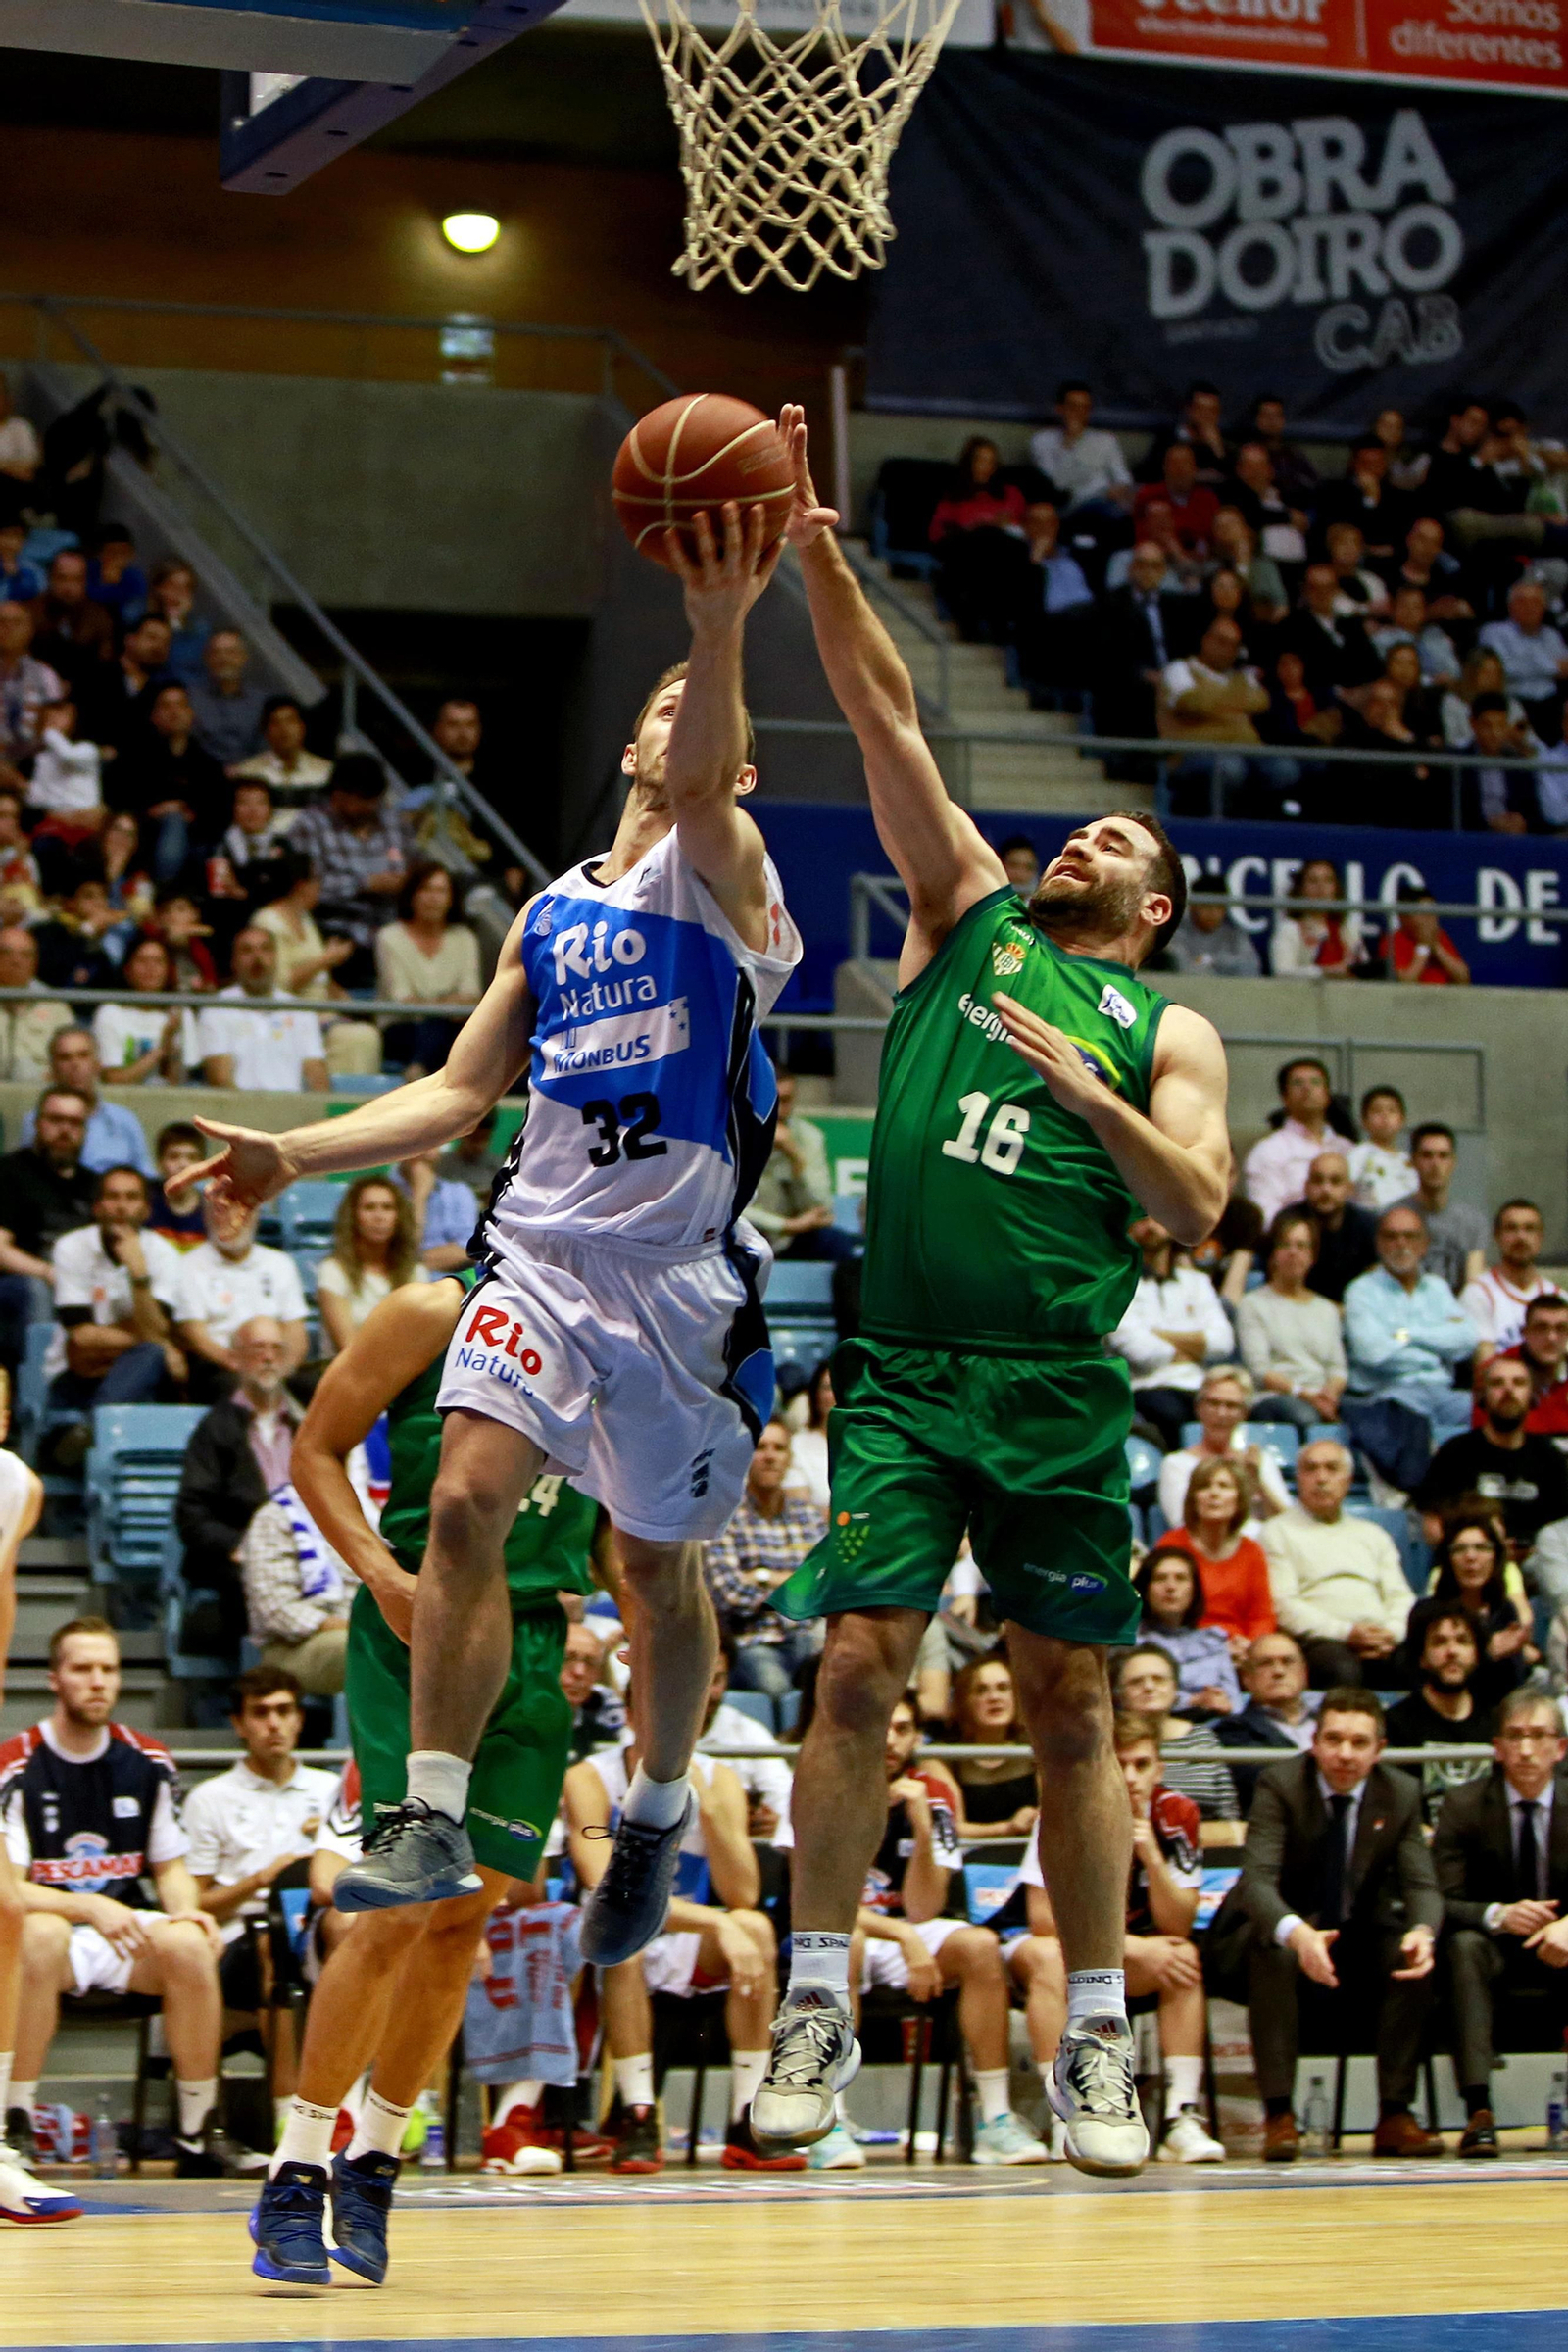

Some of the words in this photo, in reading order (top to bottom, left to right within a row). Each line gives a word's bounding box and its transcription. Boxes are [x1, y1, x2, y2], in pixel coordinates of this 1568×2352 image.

[1389, 20, 1563, 70] diferentes
[1142, 109, 1456, 229] OBRA
[1142, 204, 1463, 318] DOIRO
[1314, 296, 1463, 373] CAB
[1478, 868, 1560, 946] DE
[553, 920, 647, 986] Rio
[559, 975, 658, 1022] Natura
[553, 1035, 651, 1074] MONBUS
[581, 1091, 667, 1167] 32
[942, 1091, 1030, 1175] 16
[466, 1305, 542, 1376] Rio
